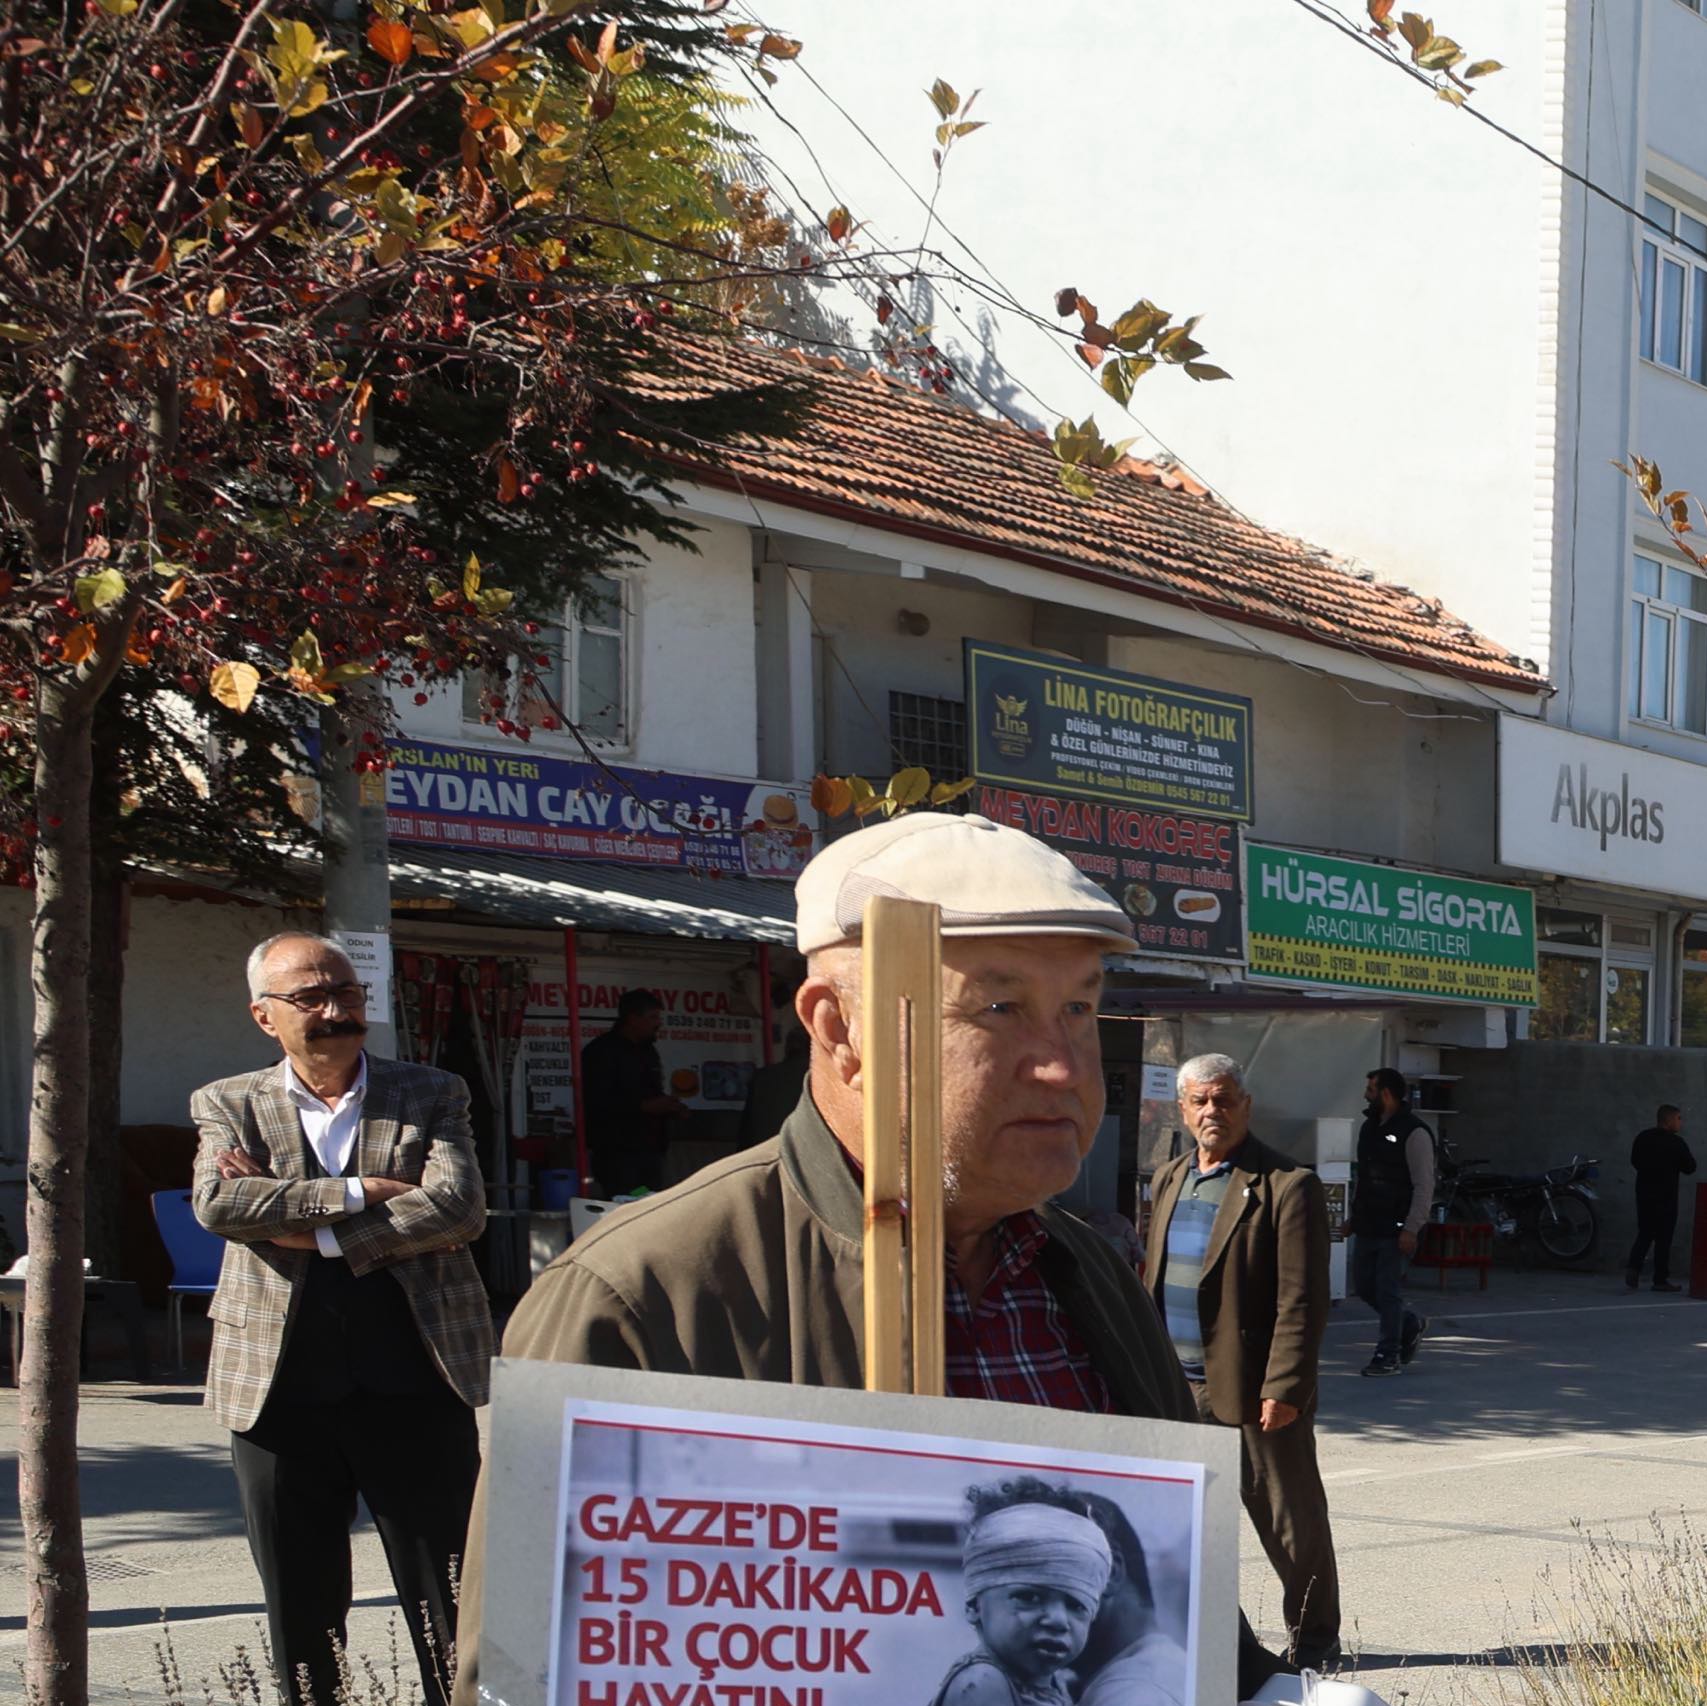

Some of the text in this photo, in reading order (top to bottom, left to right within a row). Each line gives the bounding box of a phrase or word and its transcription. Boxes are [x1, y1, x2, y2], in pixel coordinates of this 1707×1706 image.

[995, 712, 1029, 735] Lina
[1044, 675, 1238, 743] LİNA FOTOĞRAFÇILIK
[1062, 733, 1087, 752] ÖZEL
[1089, 740, 1161, 764] GÜNLERİNİZDE
[1162, 752, 1234, 778] HİZMETİNDEYİZ
[1066, 716, 1103, 737] DÜĞÜN
[1112, 725, 1142, 745] NİŞAN
[1151, 733, 1189, 753] SÜNNET
[538, 785, 613, 828] ÇAY
[980, 786, 1233, 870] MEYDAN KOKOREÇ
[1551, 762, 1665, 852] Akplas
[1122, 858, 1150, 880] TOST
[1261, 858, 1522, 936] HÜRSAL SİGORTA
[347, 939, 374, 948] ODUN
[348, 952, 376, 961] ESİLİR
[1305, 914, 1470, 957] ARACILIK HİZMETLERİ
[1254, 944, 1285, 963] TRAFİK
[1293, 950, 1321, 967] KASKO
[1330, 951, 1357, 973] İŞYERİ
[1365, 960, 1391, 976] KONUT
[1400, 963, 1429, 980] TARSİM
[1507, 975, 1532, 993] SAĞLIK
[579, 1494, 838, 1552] GAZZE'DE
[581, 1556, 945, 1617] 15 DAKİKADA
[578, 1610, 870, 1680] BİR ÇOCUK
